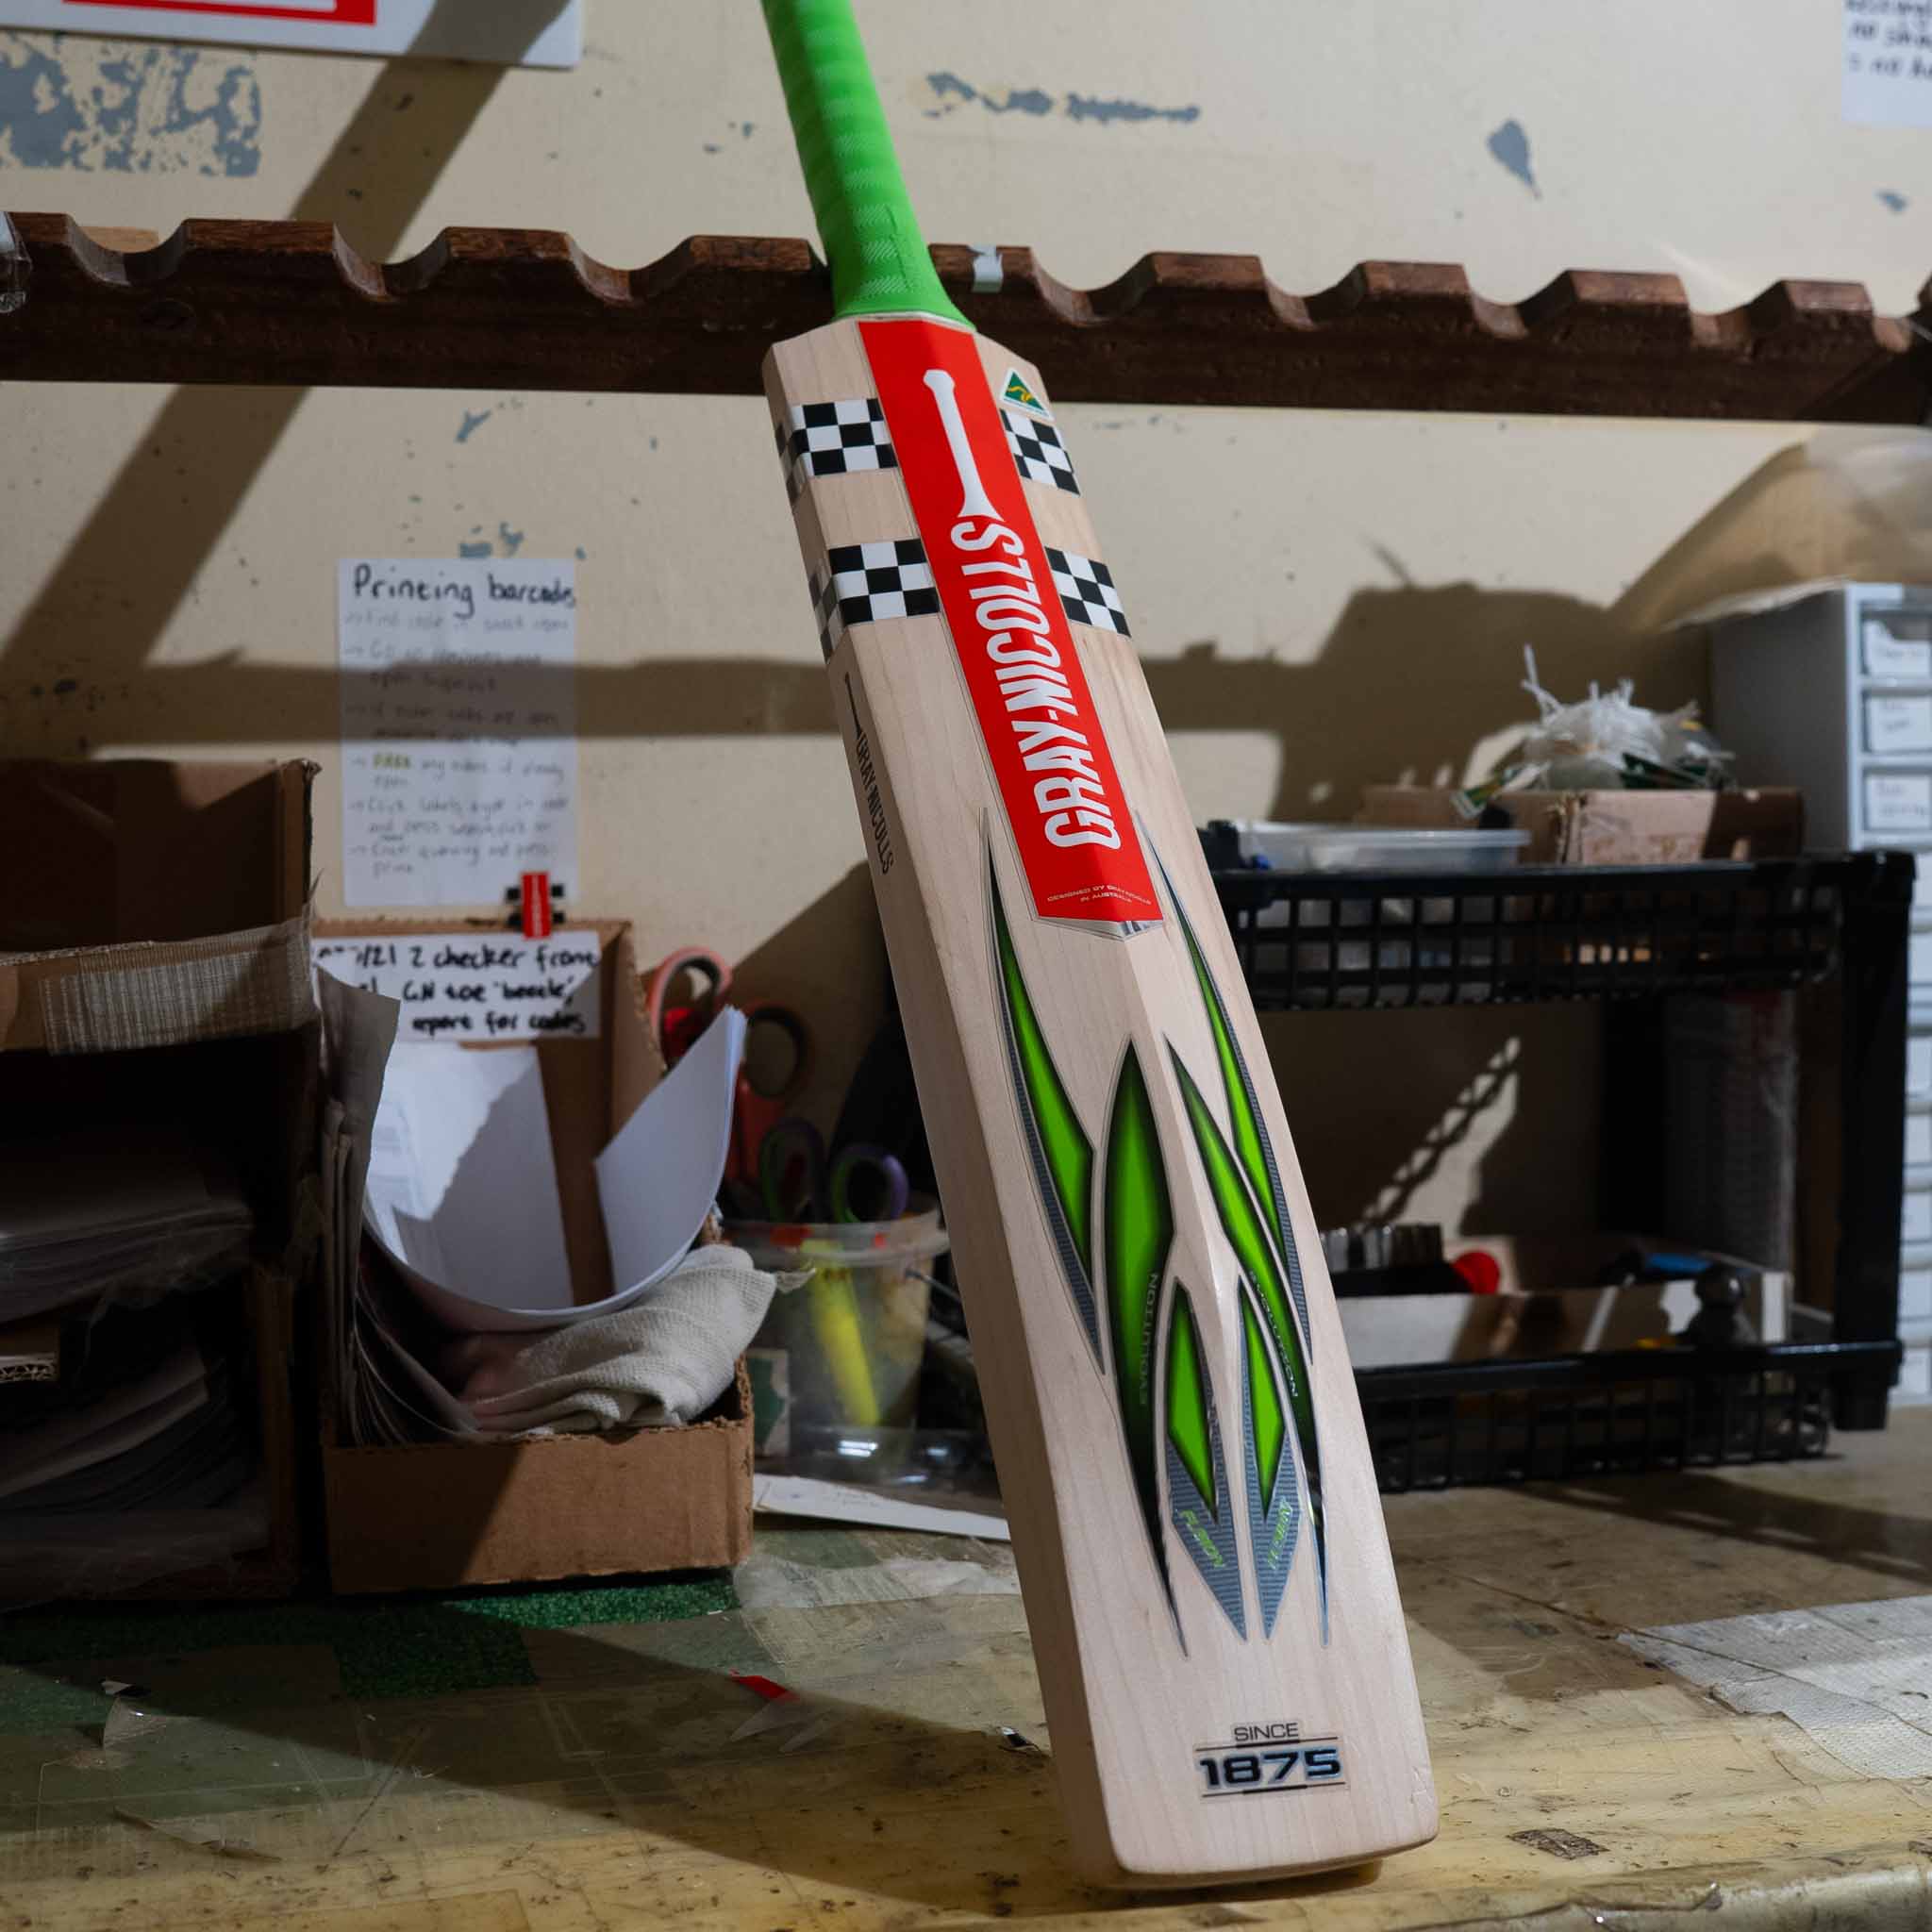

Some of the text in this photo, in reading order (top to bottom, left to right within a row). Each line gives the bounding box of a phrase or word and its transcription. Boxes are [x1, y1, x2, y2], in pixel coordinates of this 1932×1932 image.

[354, 563, 475, 620] Printing
[950, 520, 1122, 850] GRAY-NICOLLS
[433, 944, 525, 969] checker
[1234, 1723, 1299, 1742] SINCE
[1199, 1749, 1341, 1786] 1875
